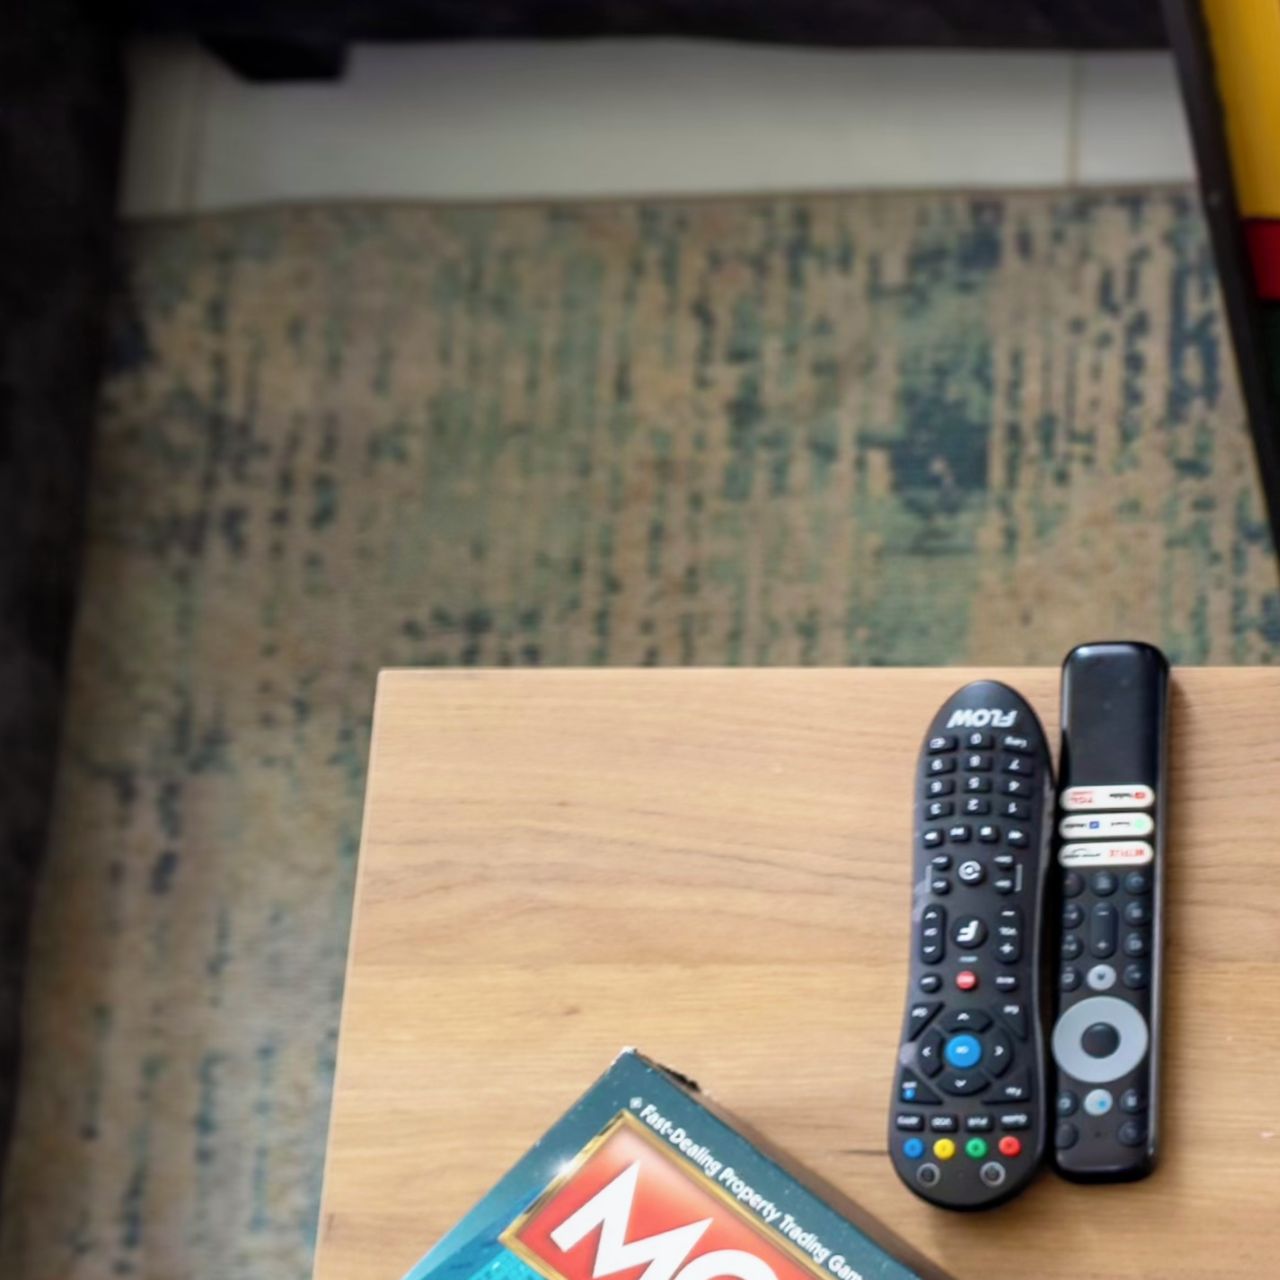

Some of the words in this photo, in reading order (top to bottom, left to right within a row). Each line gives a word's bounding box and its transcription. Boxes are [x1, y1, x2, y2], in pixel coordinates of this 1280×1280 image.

[946, 707, 1018, 729] FLOW
[640, 1104, 722, 1177] Fast-Dealing
[718, 1166, 782, 1223] Property
[779, 1213, 830, 1265] Trading
